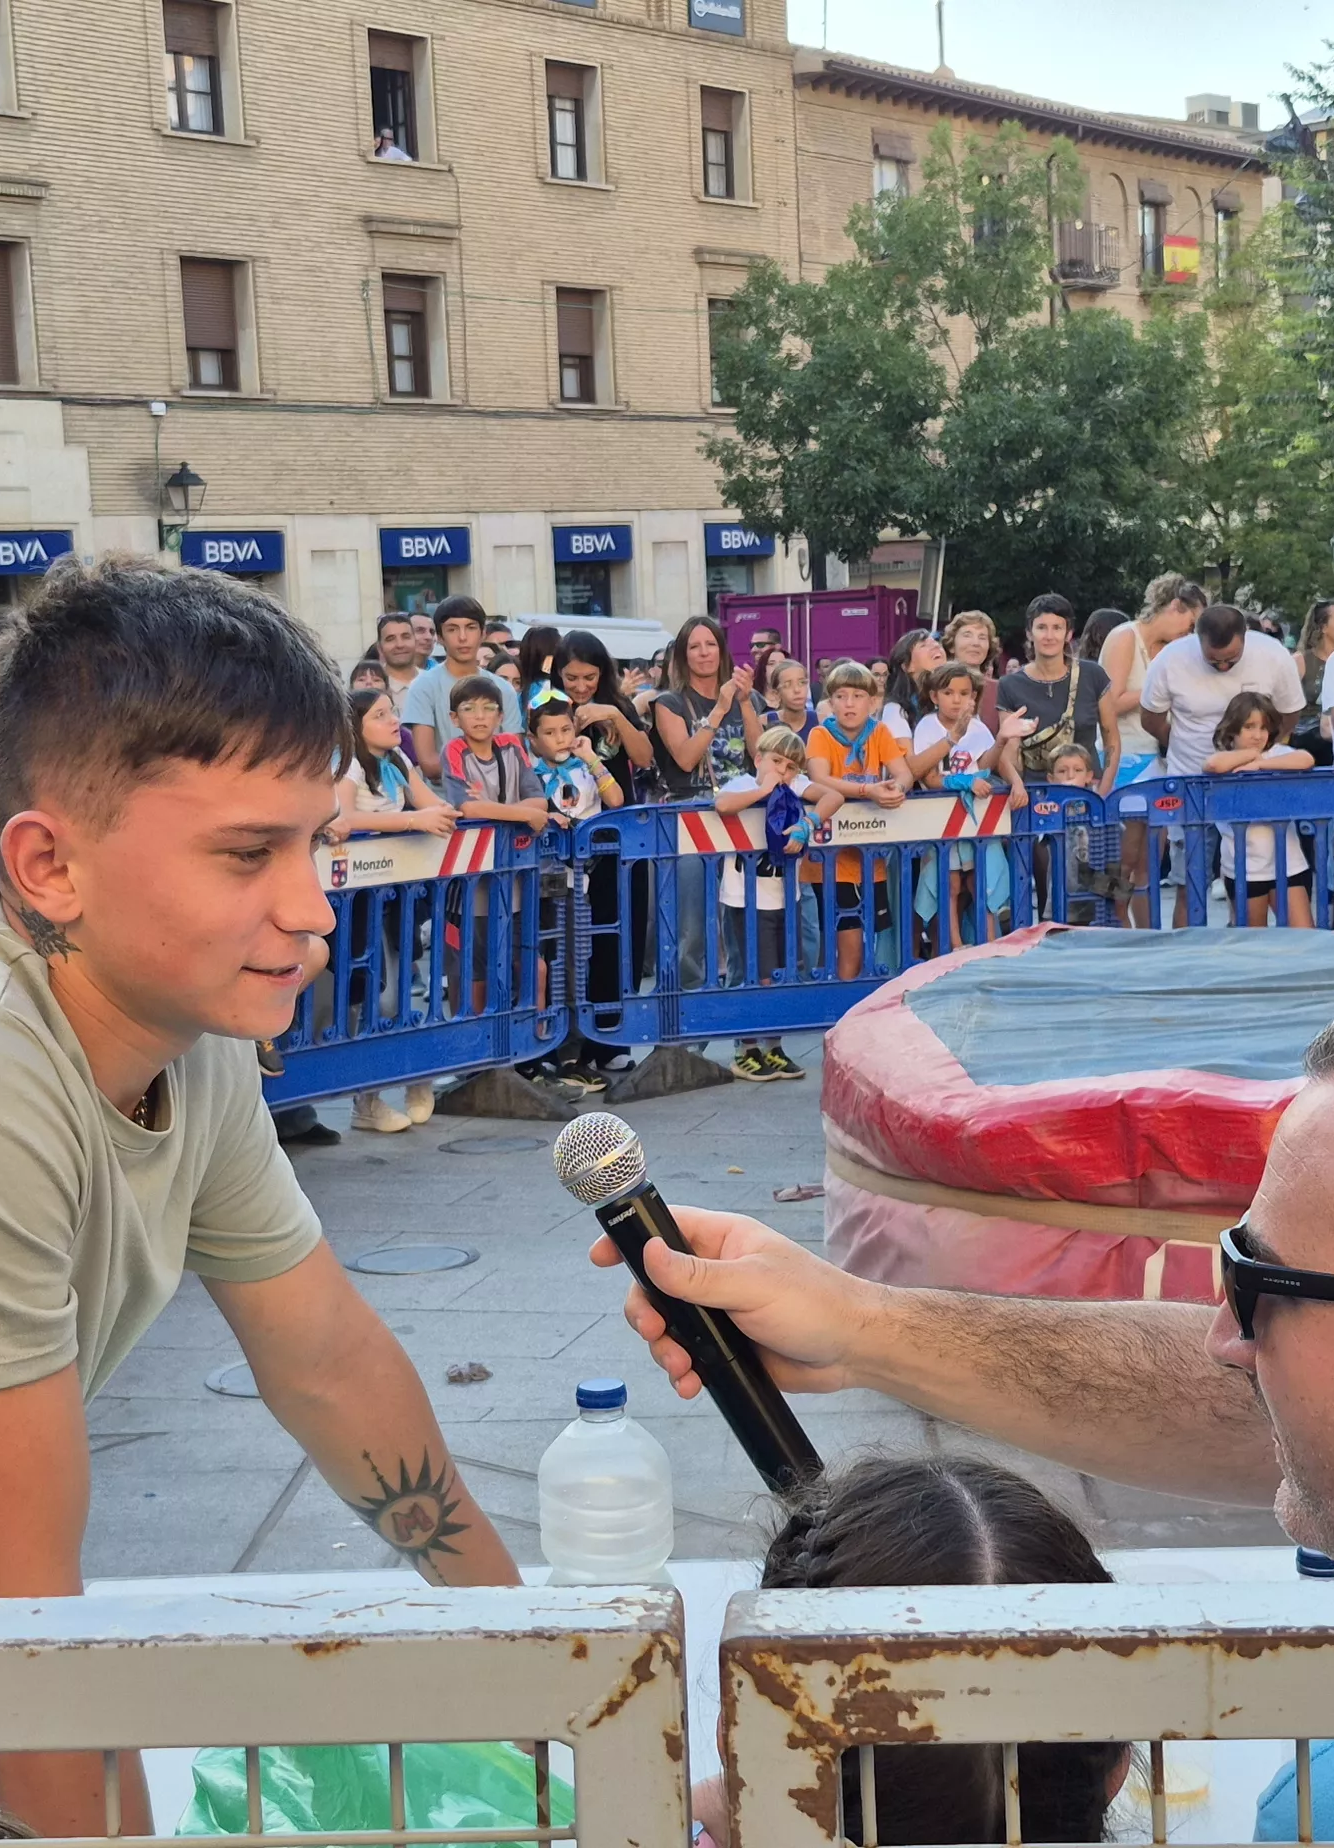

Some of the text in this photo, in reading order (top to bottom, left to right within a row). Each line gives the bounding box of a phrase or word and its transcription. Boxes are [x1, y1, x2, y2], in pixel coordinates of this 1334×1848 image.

[400, 535, 452, 558] BBVA
[571, 533, 616, 554] BBVA
[721, 531, 761, 549] BBVA
[204, 539, 263, 563] BBVA
[838, 818, 886, 831] Monzón
[352, 856, 393, 872] Monzón
